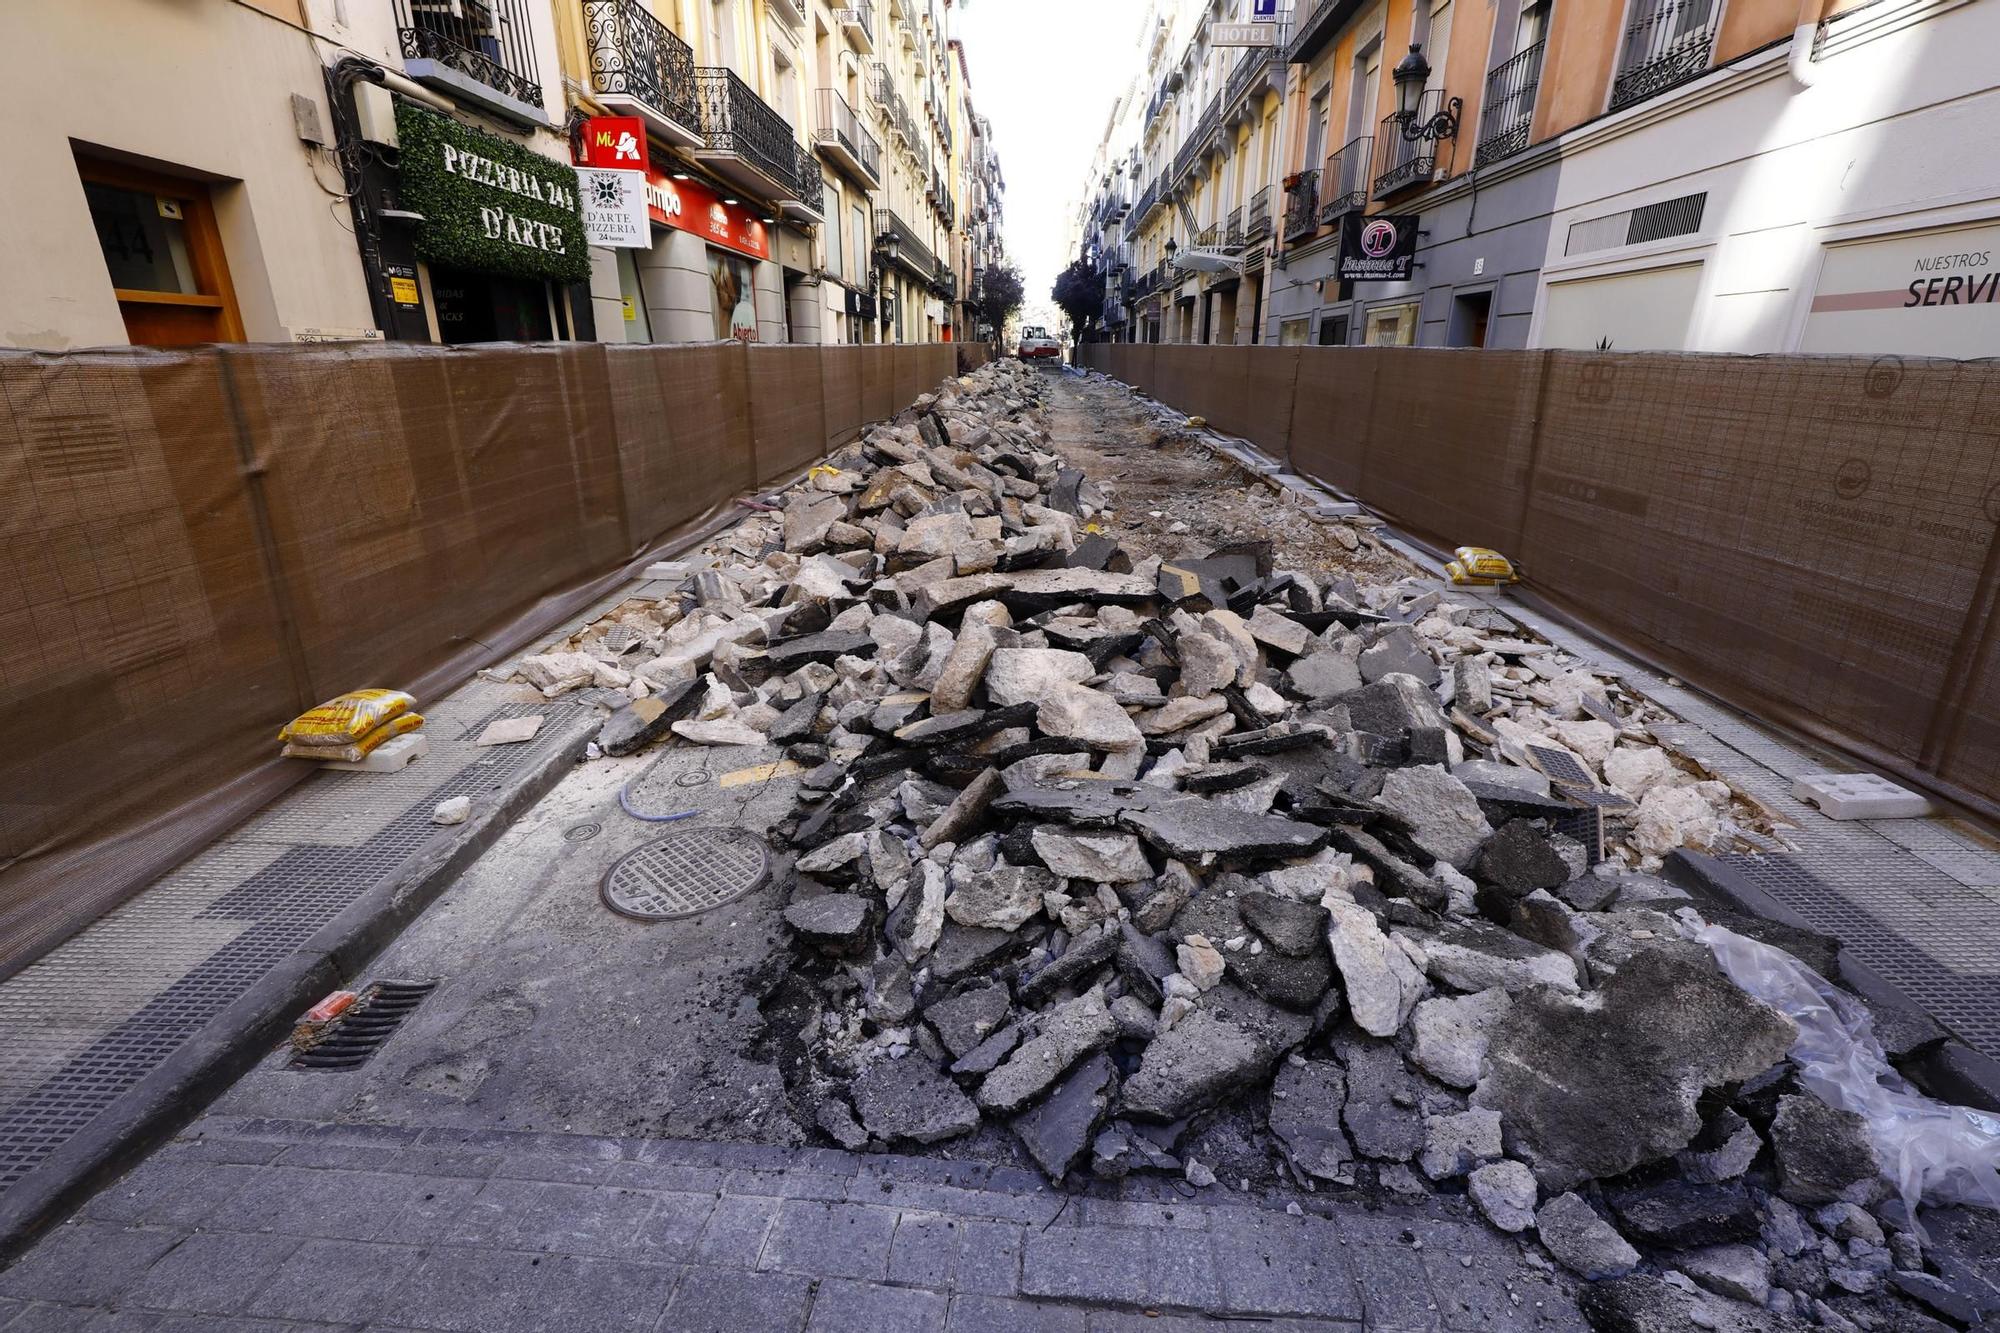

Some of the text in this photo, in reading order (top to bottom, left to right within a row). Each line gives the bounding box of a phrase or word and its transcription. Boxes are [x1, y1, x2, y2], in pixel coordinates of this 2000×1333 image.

[1218, 27, 1269, 41] HOTEL
[596, 131, 616, 147] Mi
[441, 142, 545, 202] PIZZERIA
[587, 211, 632, 224] D'ARTE
[480, 205, 566, 255] D'ARTE
[584, 222, 637, 234] PIZZERIA
[598, 232, 609, 241] 24
[1341, 254, 1412, 272] Insinua T
[1914, 250, 1992, 273] NUESTROS
[733, 322, 757, 341] Abierto
